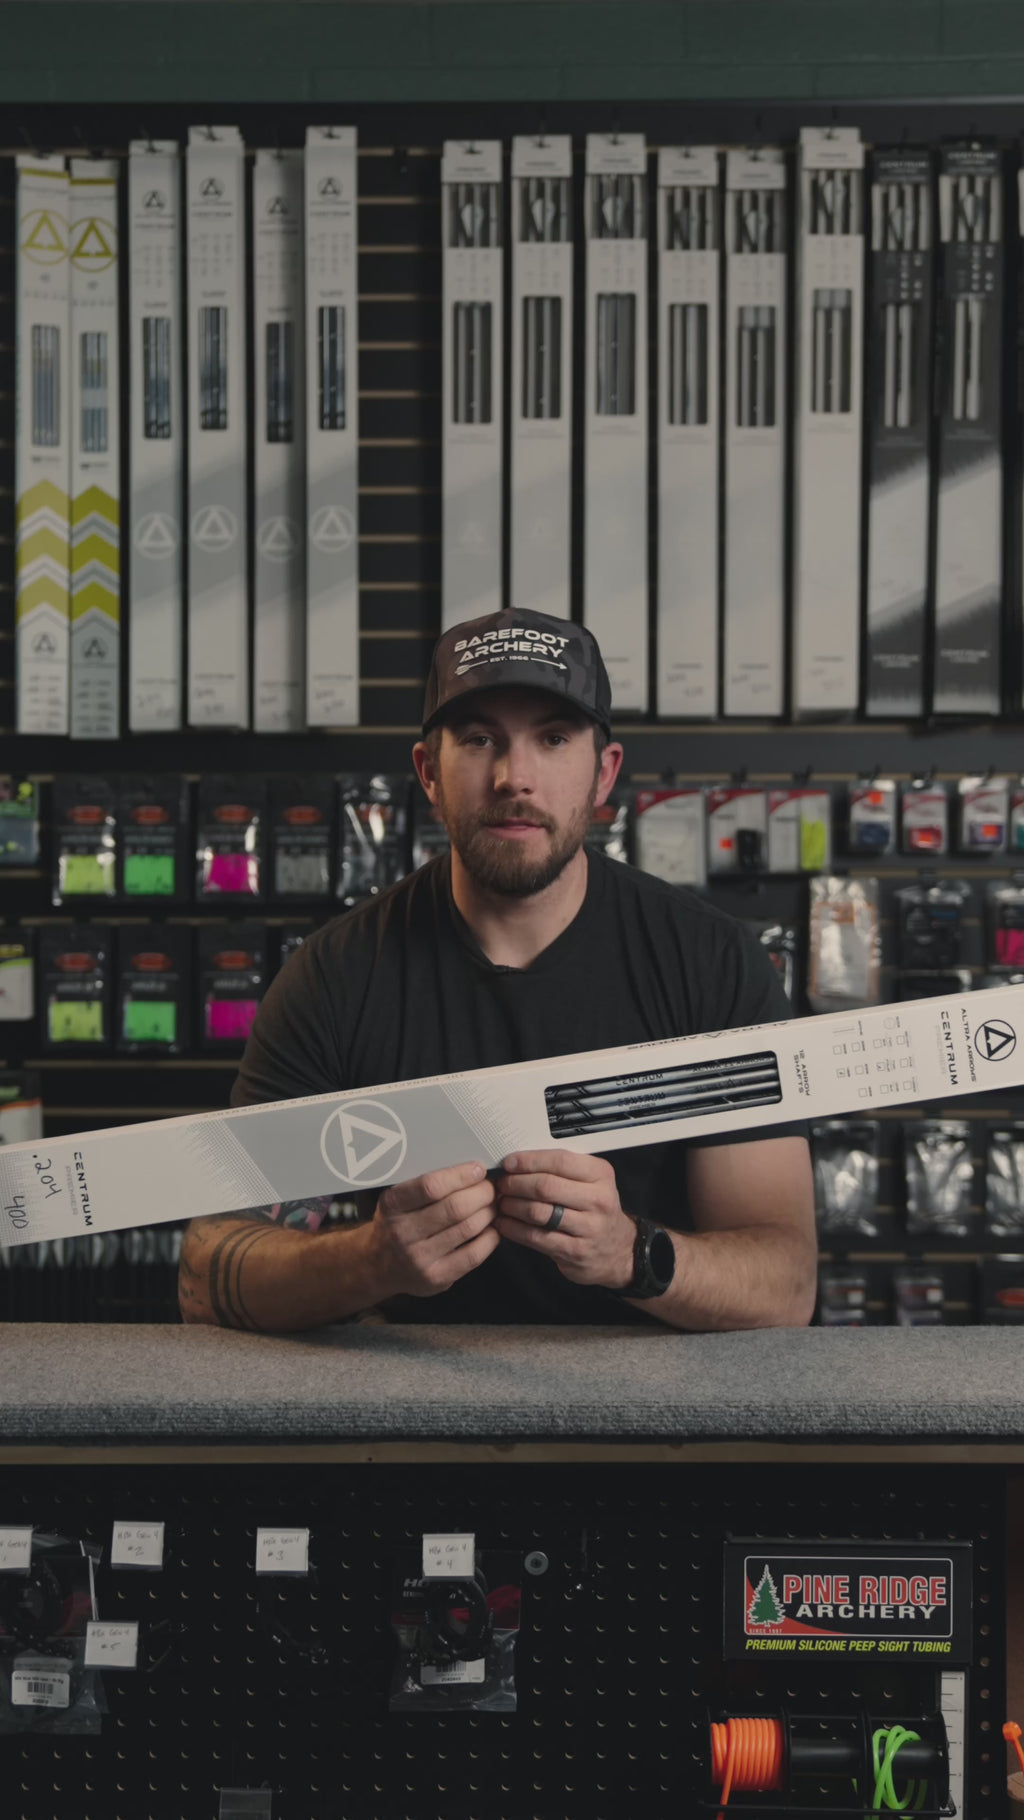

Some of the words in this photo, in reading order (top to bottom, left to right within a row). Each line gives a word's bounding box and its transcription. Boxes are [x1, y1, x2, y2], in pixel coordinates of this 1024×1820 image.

[454, 628, 570, 653] BAREFOOT
[458, 640, 564, 664] ARCHERY
[490, 655, 508, 663] EST.
[799, 1049, 805, 1059] 12
[941, 1010, 959, 1085] CENTRUM
[960, 1008, 970, 1042] ALTRA
[966, 1044, 977, 1082] ARROWS
[615, 1072, 664, 1086] CENTRUM
[793, 1053, 804, 1094] SHAFTS
[800, 1063, 811, 1097] ARROW
[32, 1154, 63, 1199] .204
[65, 1164, 79, 1216] PREMIER
[73, 1151, 93, 1227] CENTRUM
[4, 1195, 29, 1229] 400
[782, 1574, 850, 1605] PINE
[859, 1576, 947, 1606] RIDGE
[795, 1604, 937, 1620] ARCHERY
[745, 1639, 797, 1651] PREMIUM
[798, 1640, 847, 1652] SILICONE
[848, 1640, 876, 1652] PEEP
[878, 1641, 910, 1653] SIGHT
[912, 1641, 952, 1653] TUBING
